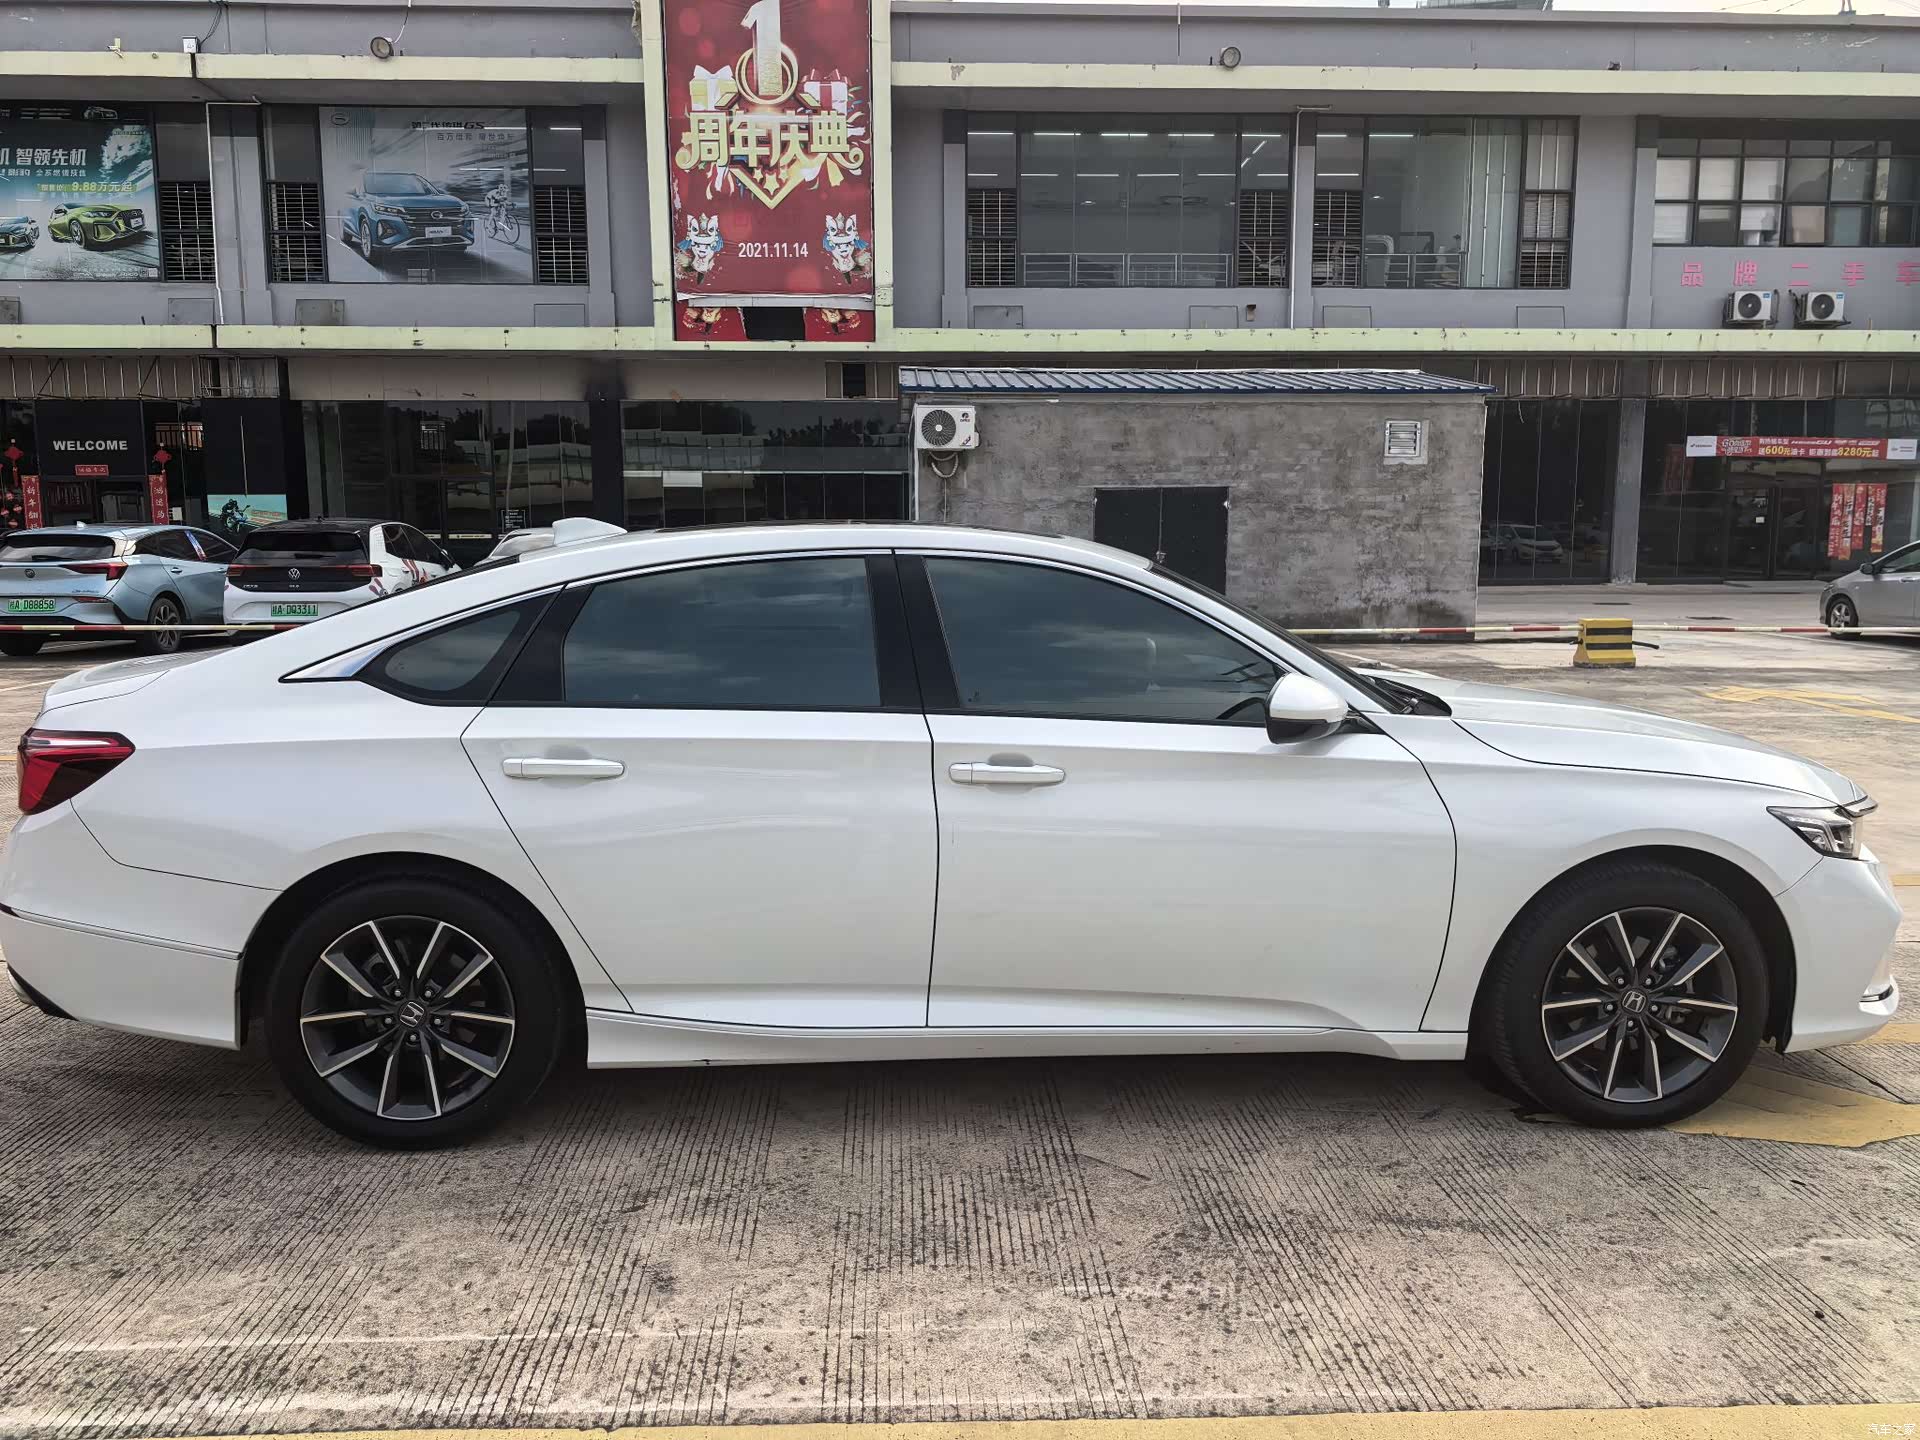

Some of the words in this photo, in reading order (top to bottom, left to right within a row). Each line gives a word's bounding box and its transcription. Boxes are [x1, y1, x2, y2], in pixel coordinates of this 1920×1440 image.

[675, 109, 865, 169] 周年庆典
[15, 148, 88, 166] 智领先机
[737, 242, 809, 258] 2021.11.14
[53, 440, 128, 451] WELCOME
